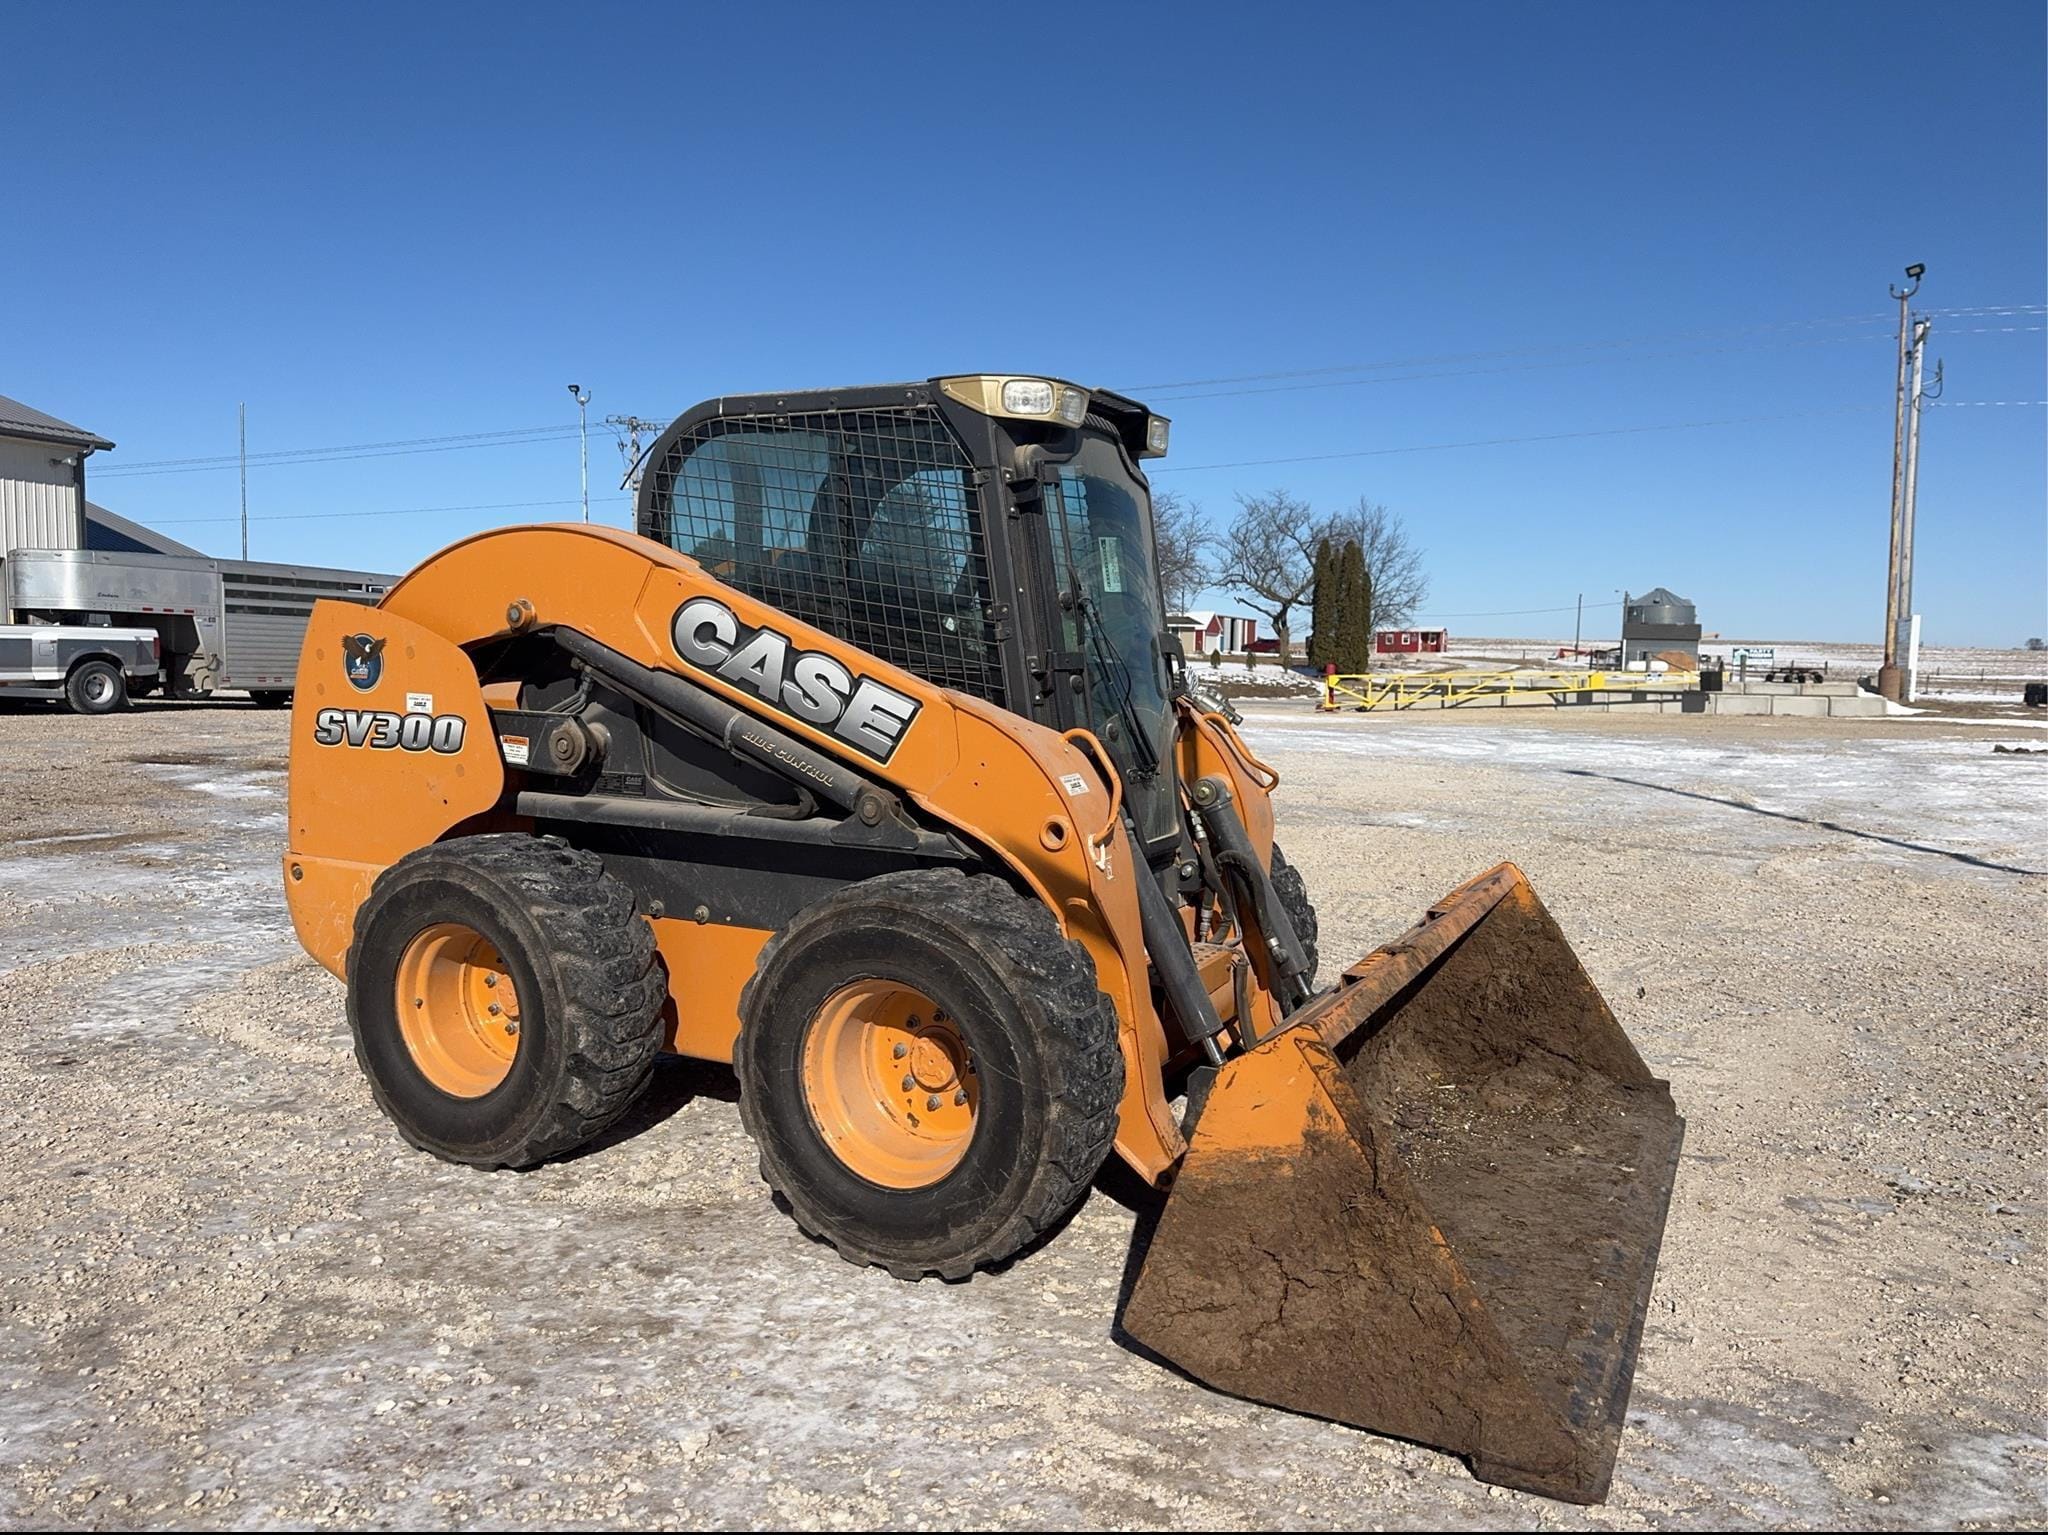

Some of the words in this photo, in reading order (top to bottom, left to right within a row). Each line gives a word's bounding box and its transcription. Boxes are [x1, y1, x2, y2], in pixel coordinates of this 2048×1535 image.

[672, 598, 923, 762] CASE
[315, 708, 466, 754] SV300
[741, 731, 776, 753] RIDE
[774, 749, 834, 787] CONTROL
